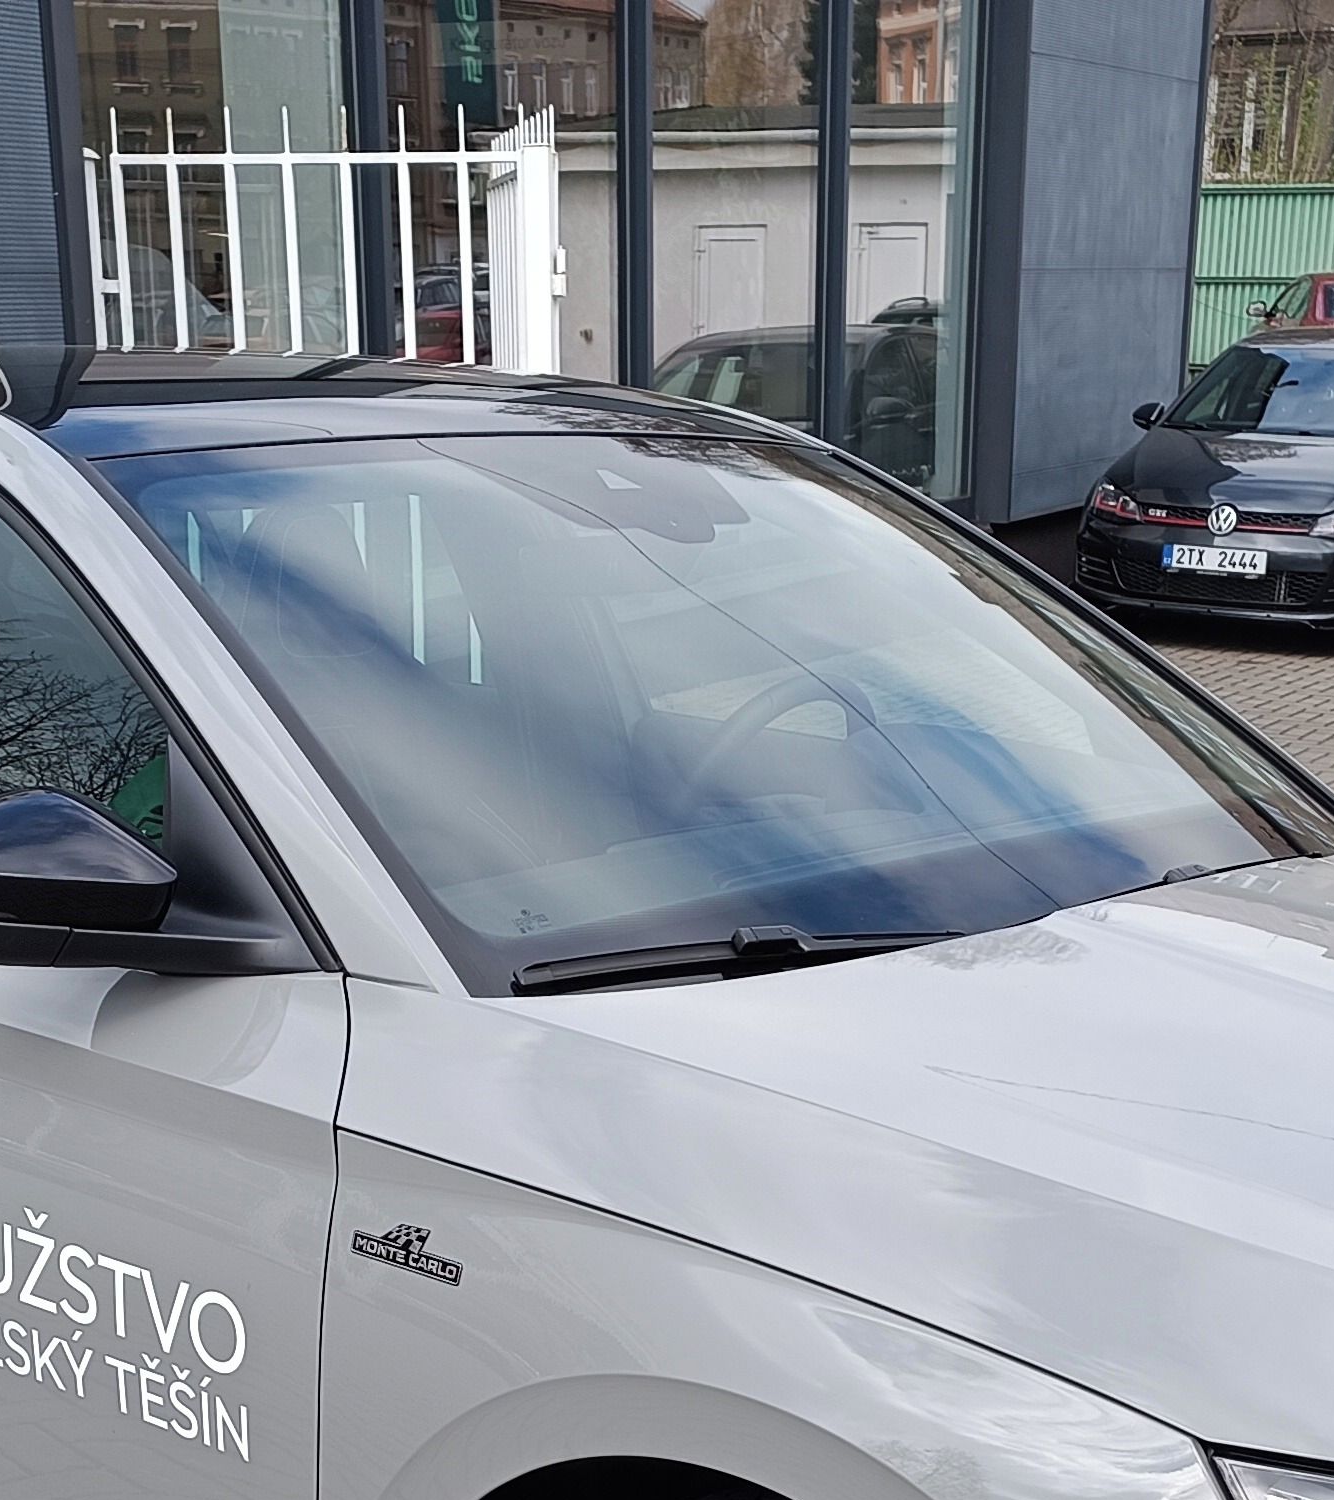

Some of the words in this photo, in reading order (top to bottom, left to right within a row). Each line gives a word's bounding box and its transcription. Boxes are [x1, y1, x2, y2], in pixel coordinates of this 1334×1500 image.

[1175, 547, 1206, 567] 2TX
[1217, 550, 1259, 571] 2444
[355, 1236, 407, 1263] MONTE
[408, 1253, 457, 1280] CARLO
[104, 1352, 250, 1463] TĚŠÍN
